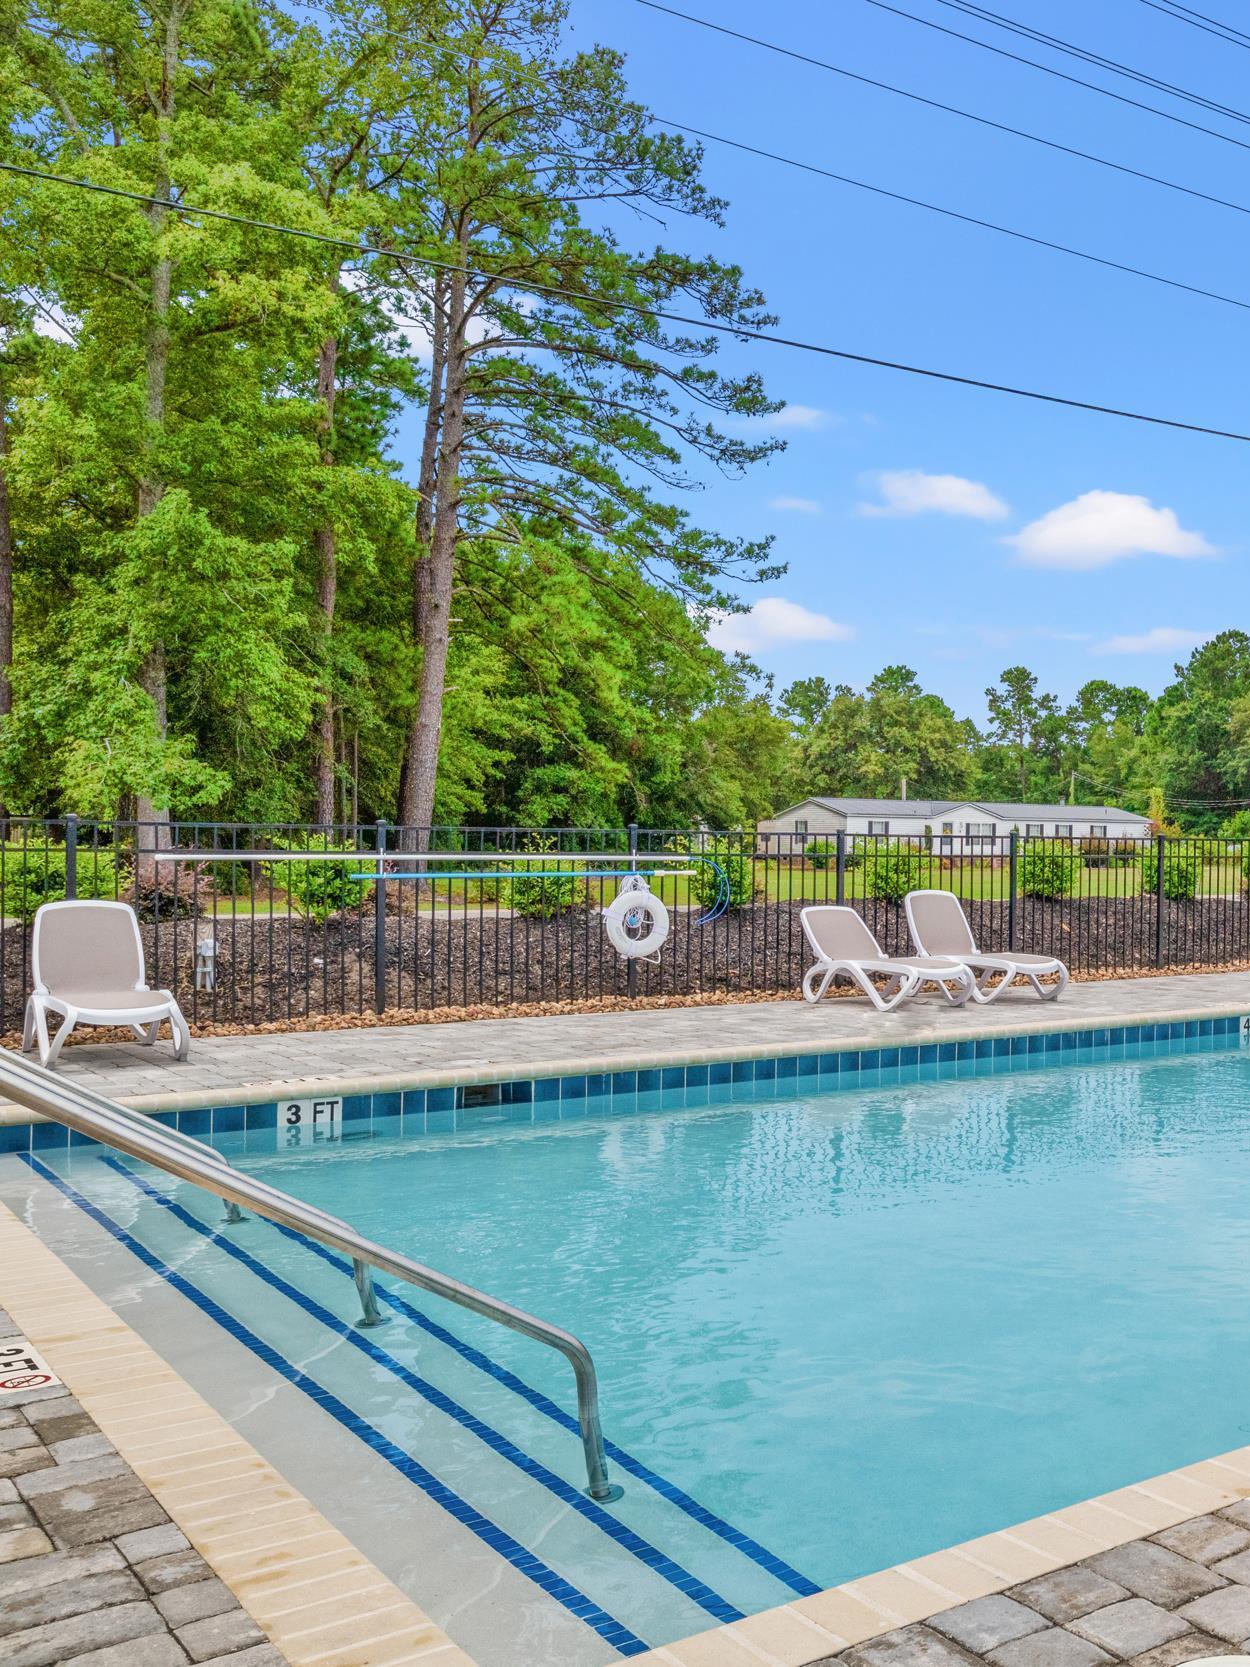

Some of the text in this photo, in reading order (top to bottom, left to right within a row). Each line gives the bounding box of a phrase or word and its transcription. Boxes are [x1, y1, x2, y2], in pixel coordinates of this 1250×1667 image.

[1243, 1017, 1250, 1031] 4
[286, 1100, 340, 1125] 3 FT
